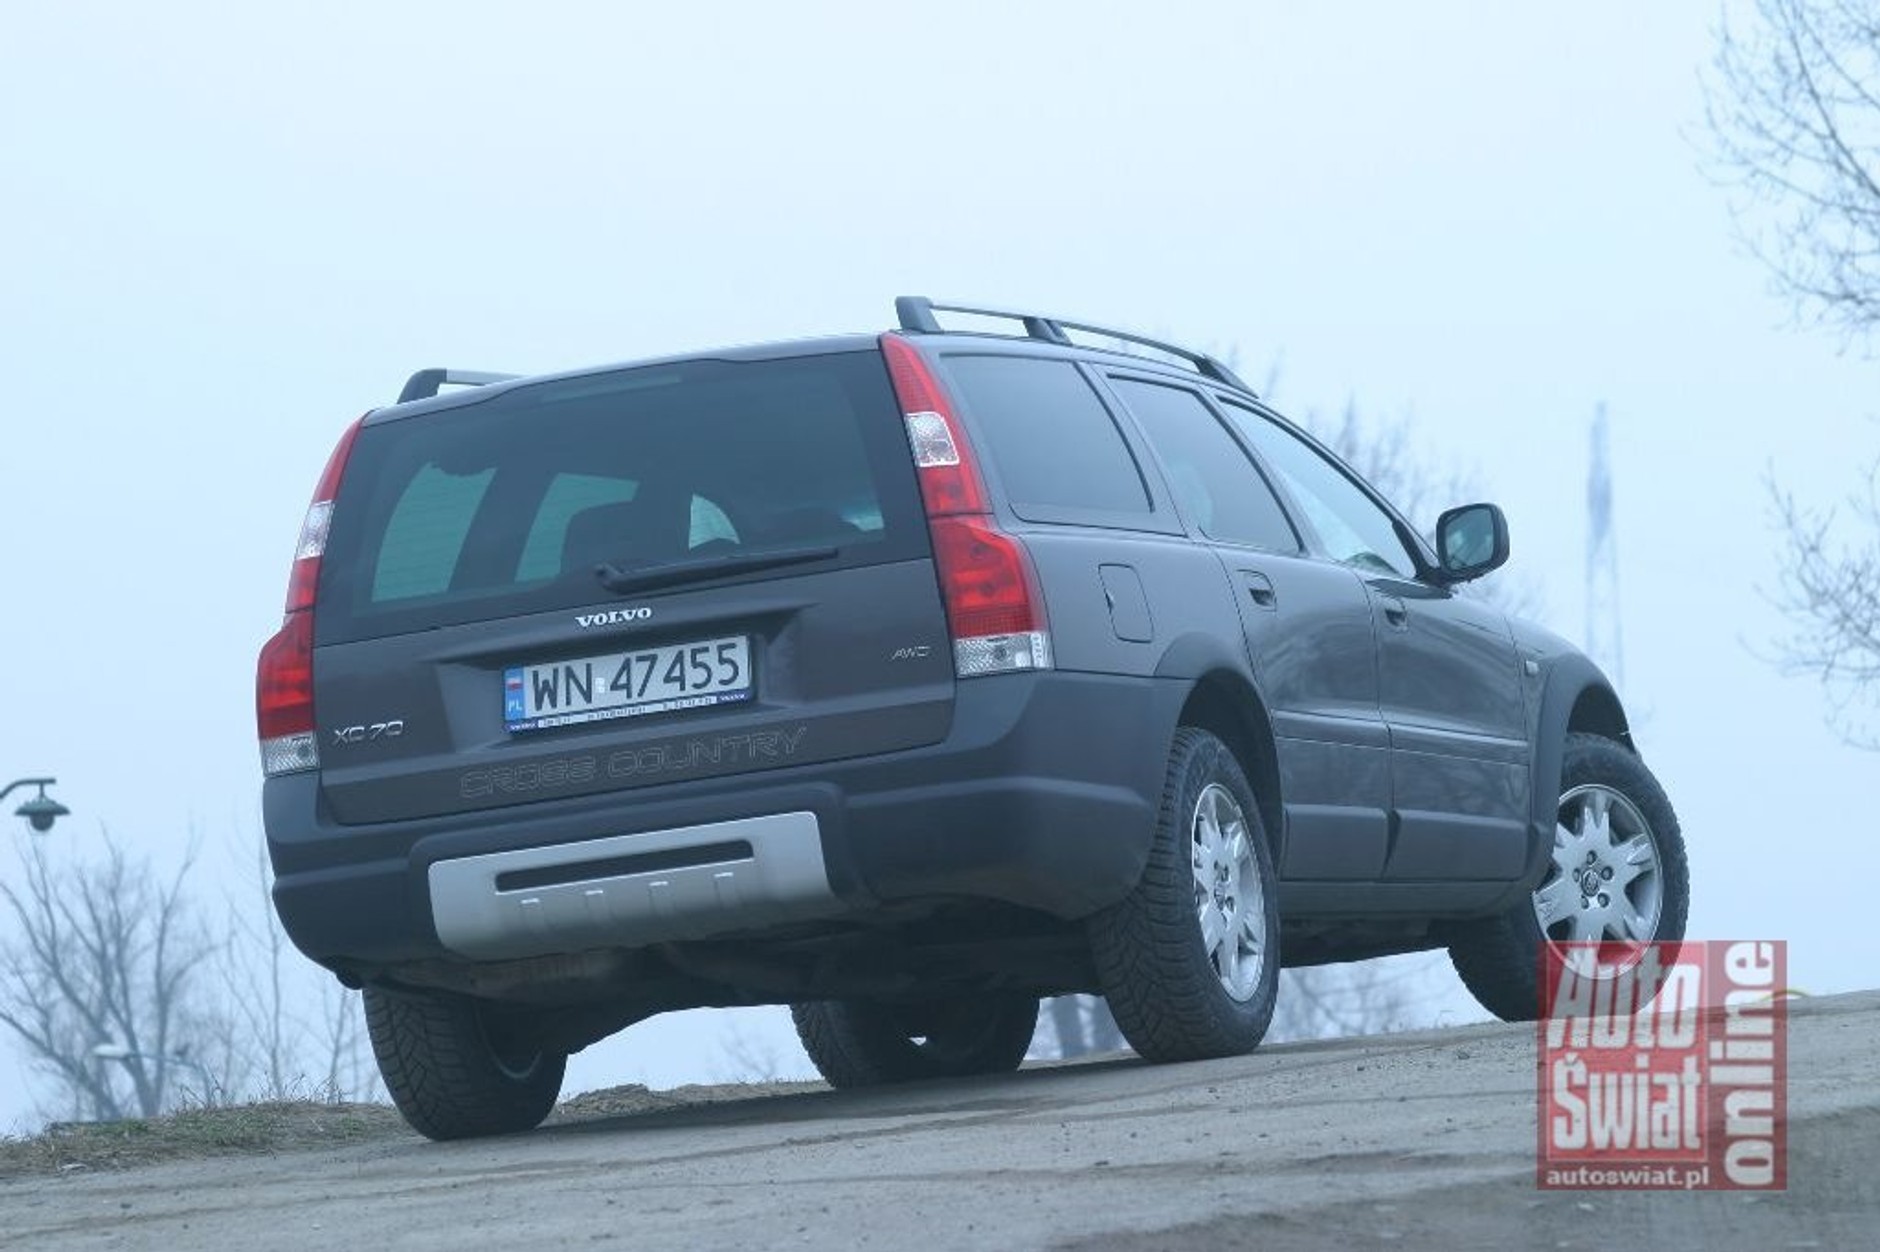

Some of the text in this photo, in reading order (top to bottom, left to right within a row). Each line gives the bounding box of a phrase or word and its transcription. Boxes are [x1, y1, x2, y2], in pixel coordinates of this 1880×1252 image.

[575, 607, 652, 628] VOLVO
[532, 643, 740, 712] WN 47455
[508, 700, 523, 713] PL
[332, 720, 403, 745] XC 70
[460, 728, 807, 796] CROSS COUNTRY
